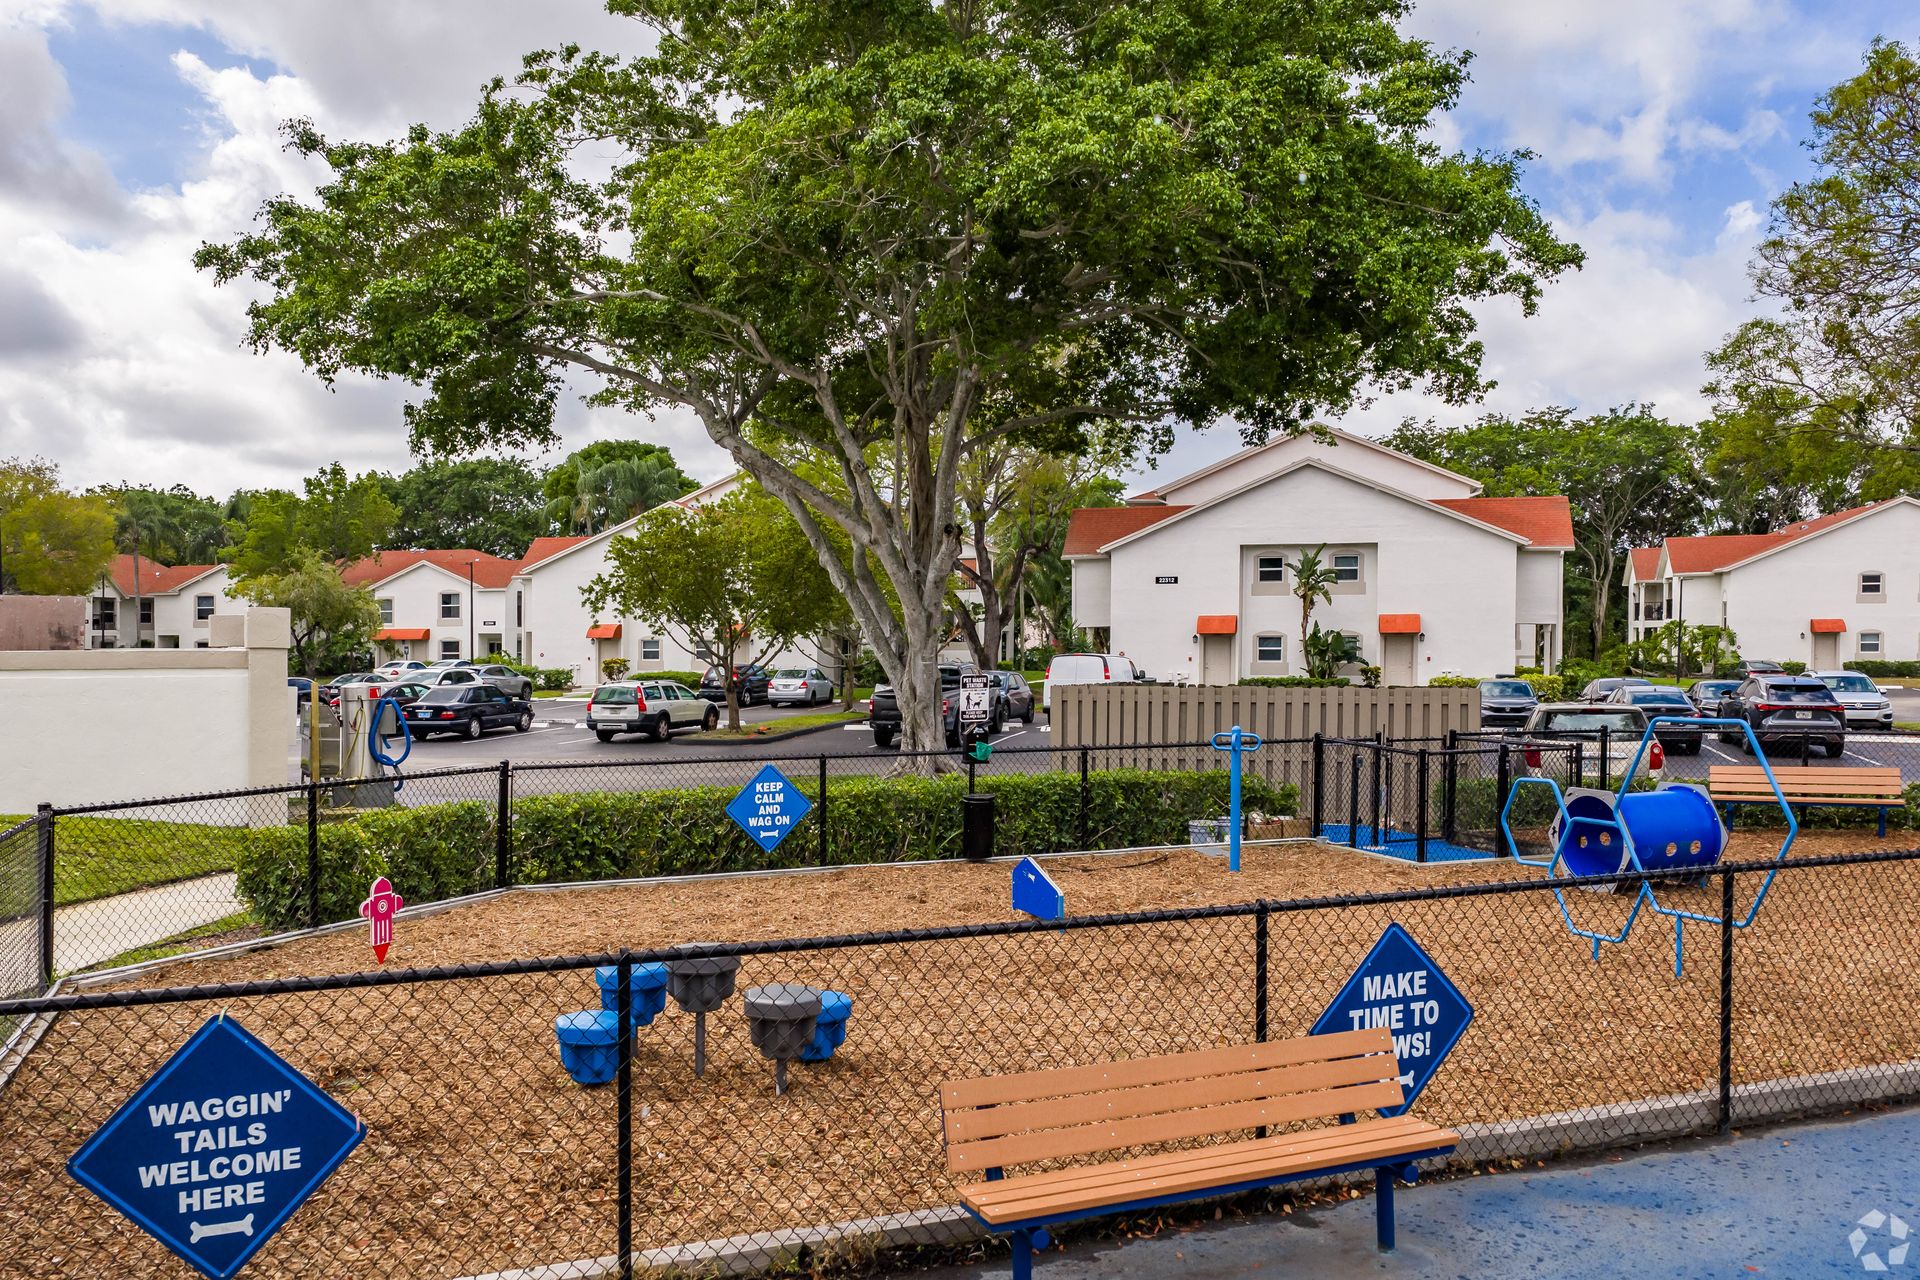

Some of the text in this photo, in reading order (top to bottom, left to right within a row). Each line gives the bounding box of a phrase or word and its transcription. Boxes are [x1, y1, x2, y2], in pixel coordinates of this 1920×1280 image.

[755, 793, 784, 804] CALM
[756, 782, 784, 793] KEEP
[748, 815, 790, 827] WAG ON
[758, 805, 781, 815] AND
[1363, 970, 1428, 1002] MAKE
[1349, 999, 1440, 1031] TIME TO
[174, 1122, 268, 1154] TAILS
[138, 1147, 302, 1189] WELCOME
[178, 1181, 266, 1214] HERE
